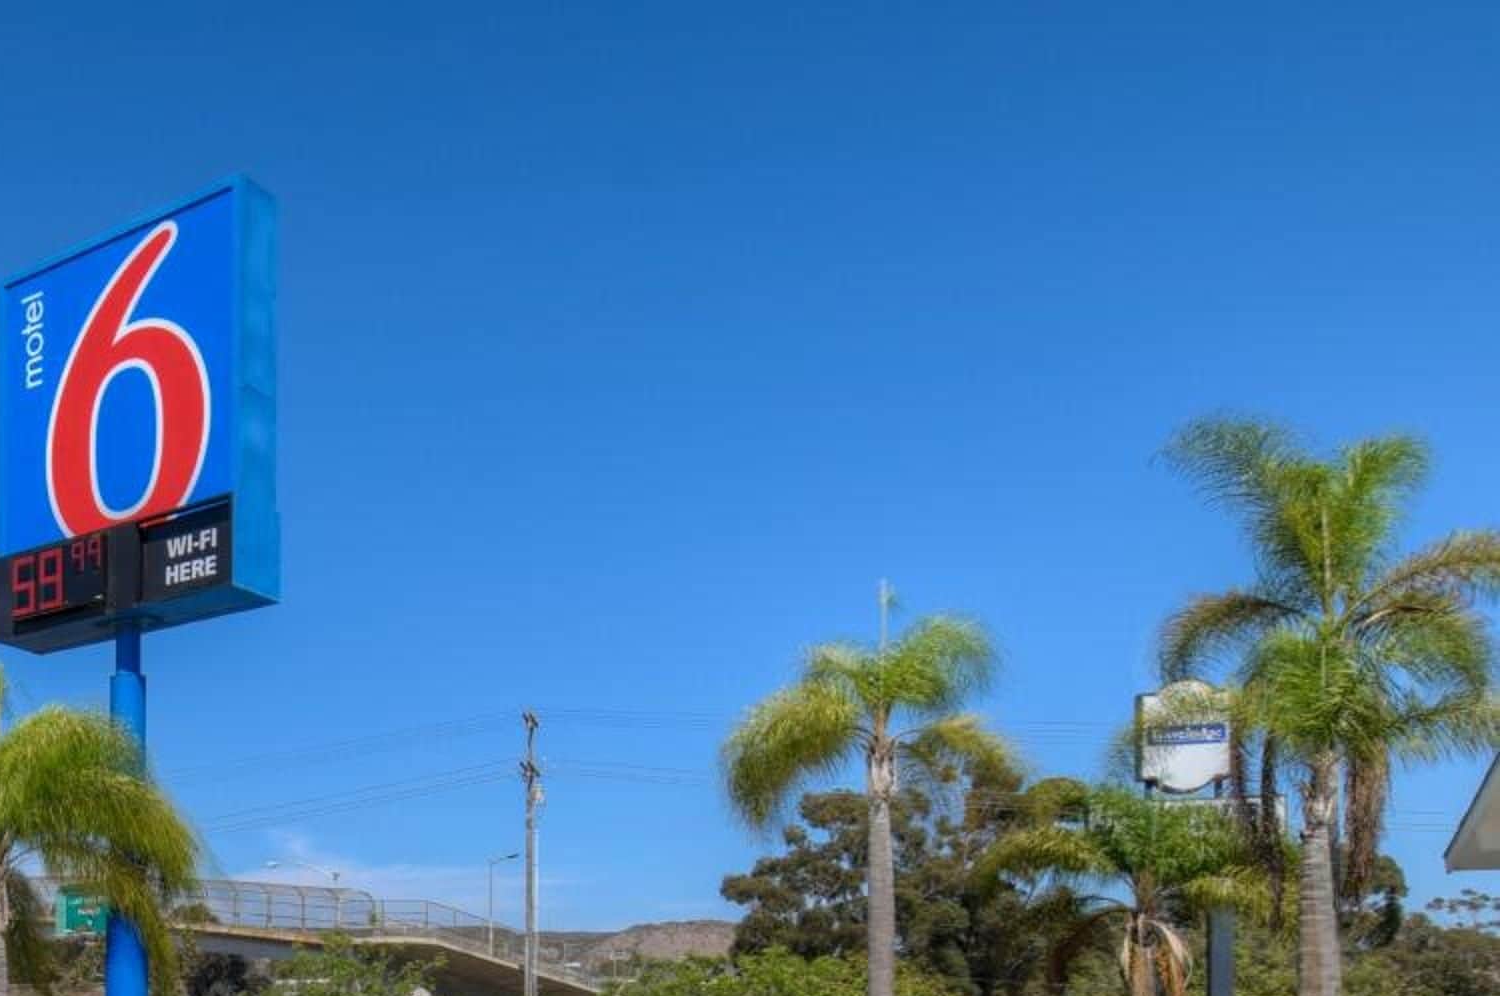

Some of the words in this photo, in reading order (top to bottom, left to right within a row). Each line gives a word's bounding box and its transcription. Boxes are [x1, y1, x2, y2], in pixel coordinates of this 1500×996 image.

[21, 291, 44, 389] motel
[46, 220, 211, 539] 6
[165, 556, 217, 585] HERE
[166, 527, 217, 559] WI-FI
[11, 548, 65, 618] 59
